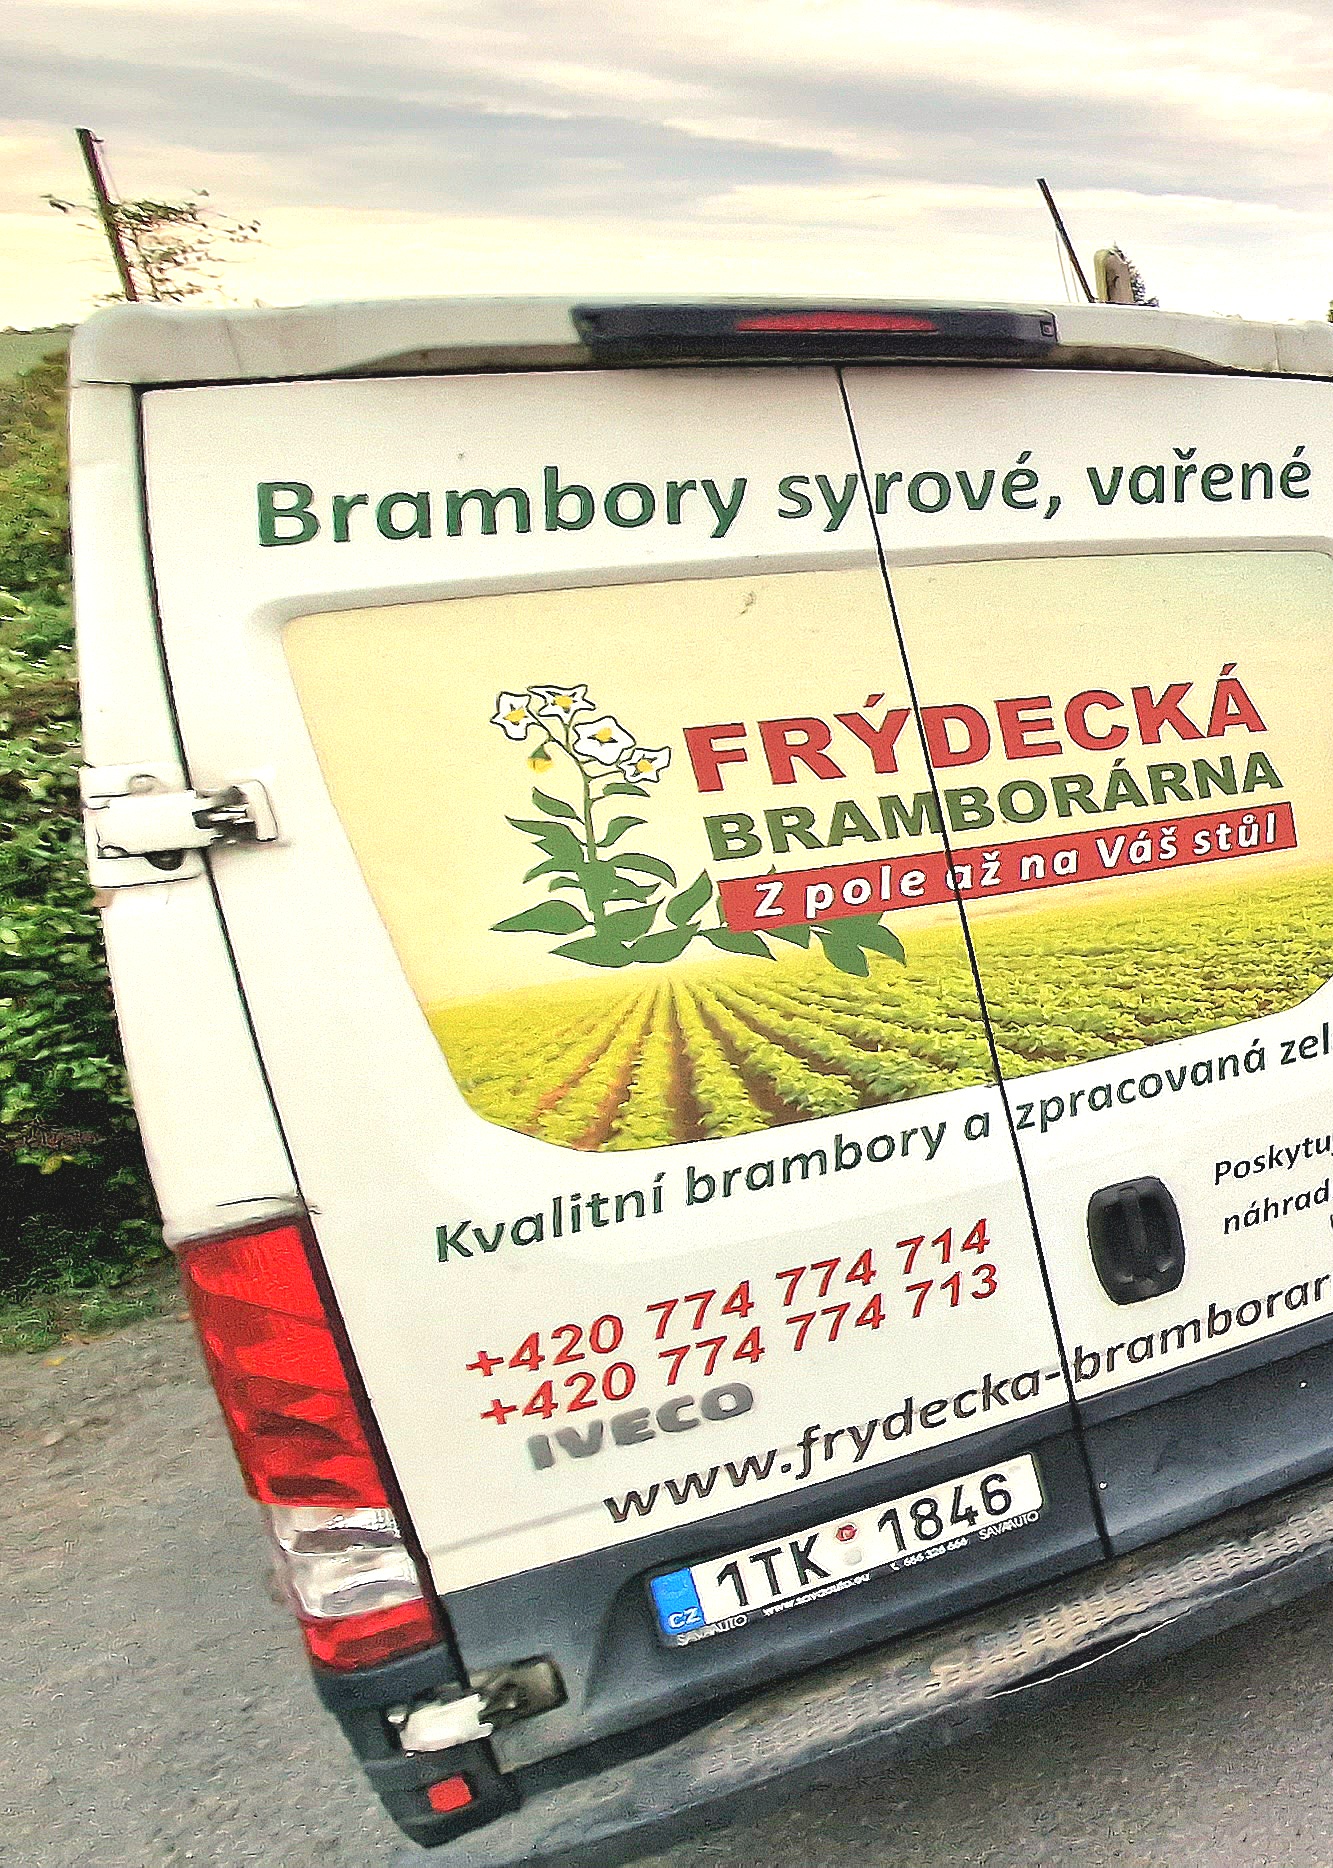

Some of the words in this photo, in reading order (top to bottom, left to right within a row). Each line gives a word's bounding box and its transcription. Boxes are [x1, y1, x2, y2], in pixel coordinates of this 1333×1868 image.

[257, 467, 747, 548] Brambory
[777, 450, 1062, 532] syrové,
[1087, 446, 1313, 505] vařené
[683, 663, 1268, 794] FRÝDECKÁ
[703, 751, 1284, 862] BRAMBORÁRNA
[753, 879, 786, 918] Z
[804, 855, 927, 921] pole
[946, 849, 1002, 893] až
[1021, 846, 1079, 882] na
[1096, 825, 1179, 870] Váš
[1193, 811, 1278, 857] stůl
[435, 1172, 666, 1262] Kvalitní
[687, 1121, 946, 1206] brambory
[963, 1110, 991, 1141] a
[1015, 1040, 1267, 1134] zpracovaná
[465, 1313, 625, 1377] +420
[646, 1280, 756, 1340] 774
[775, 1248, 877, 1307] 774
[895, 1217, 992, 1274] 714
[480, 1361, 637, 1425] +420
[658, 1326, 766, 1386] 774
[785, 1292, 886, 1352] 774
[904, 1263, 999, 1319] 713
[524, 1381, 756, 1473] IVECO
[716, 1532, 832, 1607] 1TK
[877, 1473, 1013, 1551] 1846
[667, 1606, 702, 1630] CZ
